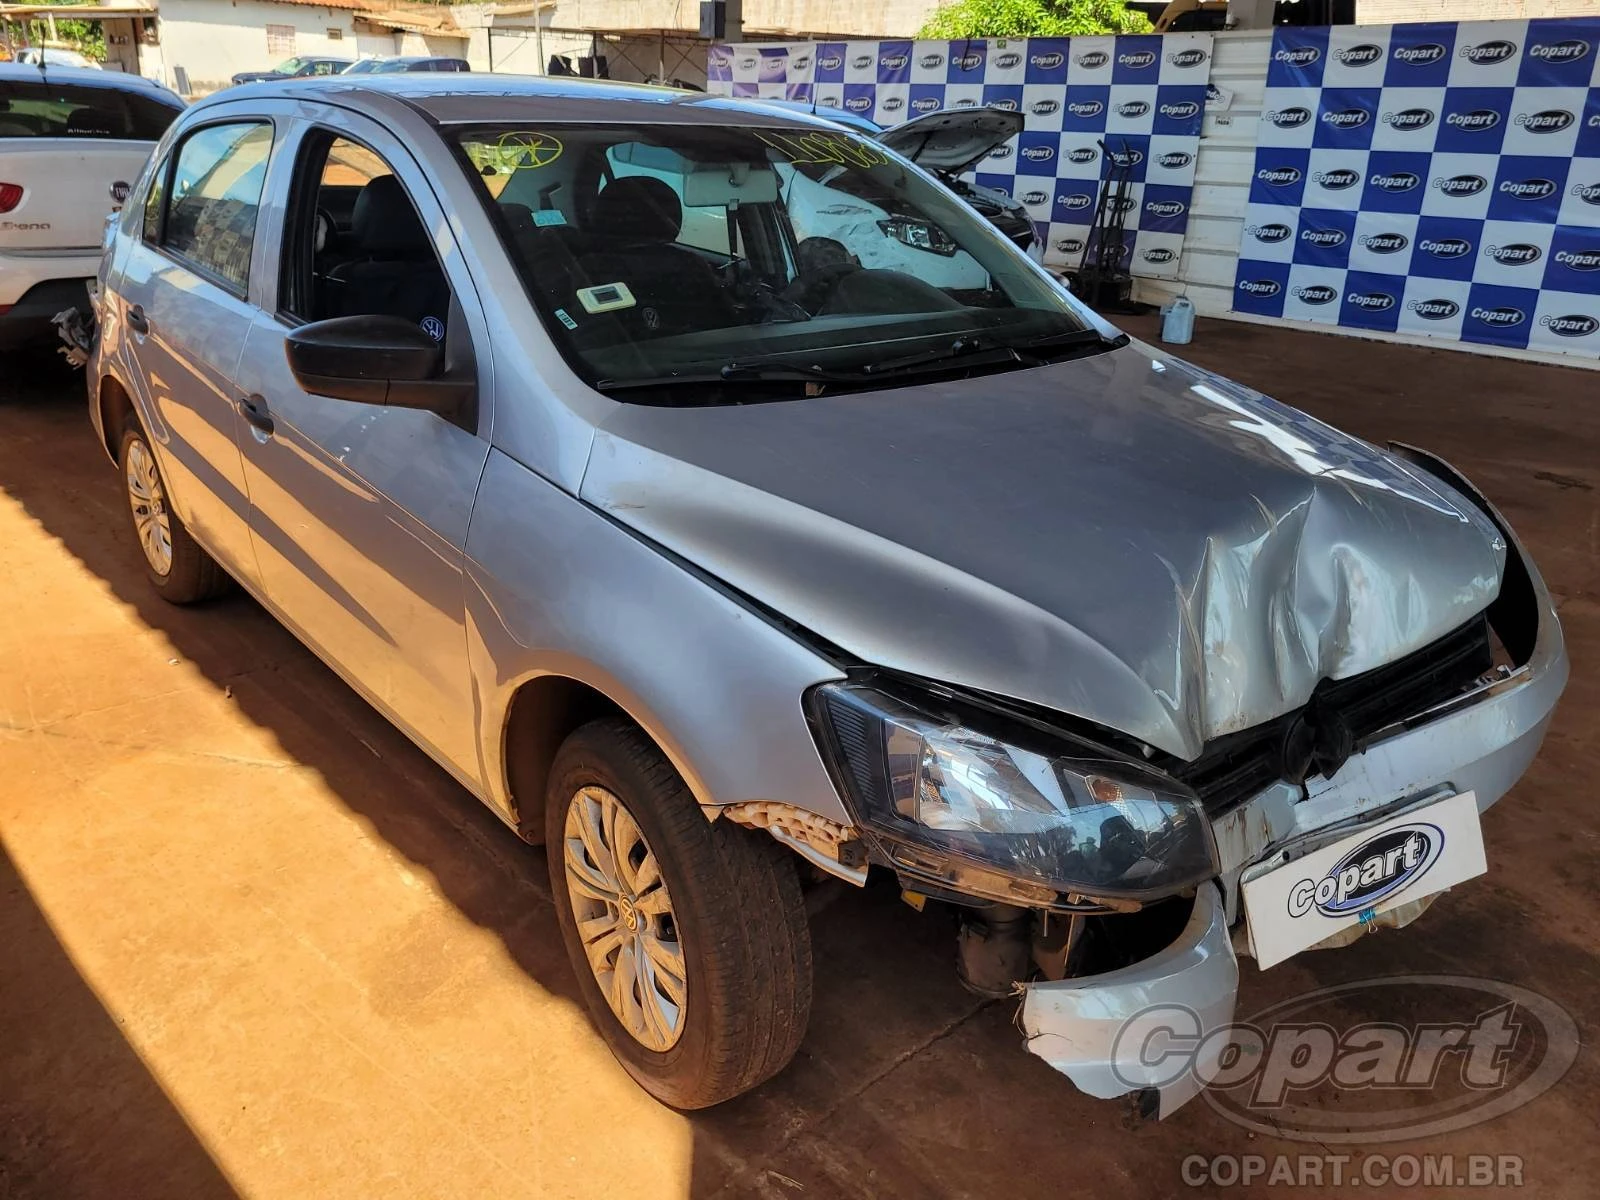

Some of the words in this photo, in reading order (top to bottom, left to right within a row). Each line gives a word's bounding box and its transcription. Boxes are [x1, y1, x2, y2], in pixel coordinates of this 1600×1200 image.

[1118, 52, 1151, 65] Copart
[1167, 51, 1201, 65] Copart
[1275, 49, 1315, 64] Copart
[1332, 46, 1378, 62] Copart
[1394, 47, 1441, 61] Copart
[1460, 44, 1509, 60] Copart
[1529, 43, 1583, 59] Copart
[818, 57, 840, 68] Copart
[880, 57, 905, 68] Copart
[1031, 54, 1059, 66] Copart
[846, 99, 869, 109] Copart
[911, 100, 936, 110] Copart
[1068, 102, 1098, 115] Copart
[1159, 103, 1194, 117] Copart
[1267, 110, 1305, 124] Copart
[1321, 110, 1363, 125] Copart
[1383, 111, 1428, 126] Copart
[1446, 112, 1495, 127] Copart
[1514, 112, 1566, 129] Copart
[1021, 148, 1049, 160] Copart
[1257, 168, 1296, 183] Copart
[1312, 171, 1353, 185] Copart
[1370, 174, 1415, 190] Copart
[1433, 176, 1479, 193] Copart
[1499, 180, 1550, 195] Copart
[1571, 184, 1600, 199] Cop
[1057, 194, 1088, 207] Copart
[1147, 202, 1179, 215] Copart
[1248, 224, 1286, 239] Copart
[1301, 230, 1342, 245] Copart
[1359, 235, 1402, 250] Copart
[1419, 239, 1466, 255] Copart
[1484, 244, 1534, 259] Copart
[1555, 251, 1600, 266] Copar
[1239, 280, 1277, 294] Copart
[1291, 286, 1332, 301] Copart
[1348, 293, 1390, 308] Copart
[1407, 300, 1452, 315] Copart
[1471, 307, 1519, 324] Copart
[1539, 315, 1591, 332] Copart
[1287, 831, 1421, 918] Copart
